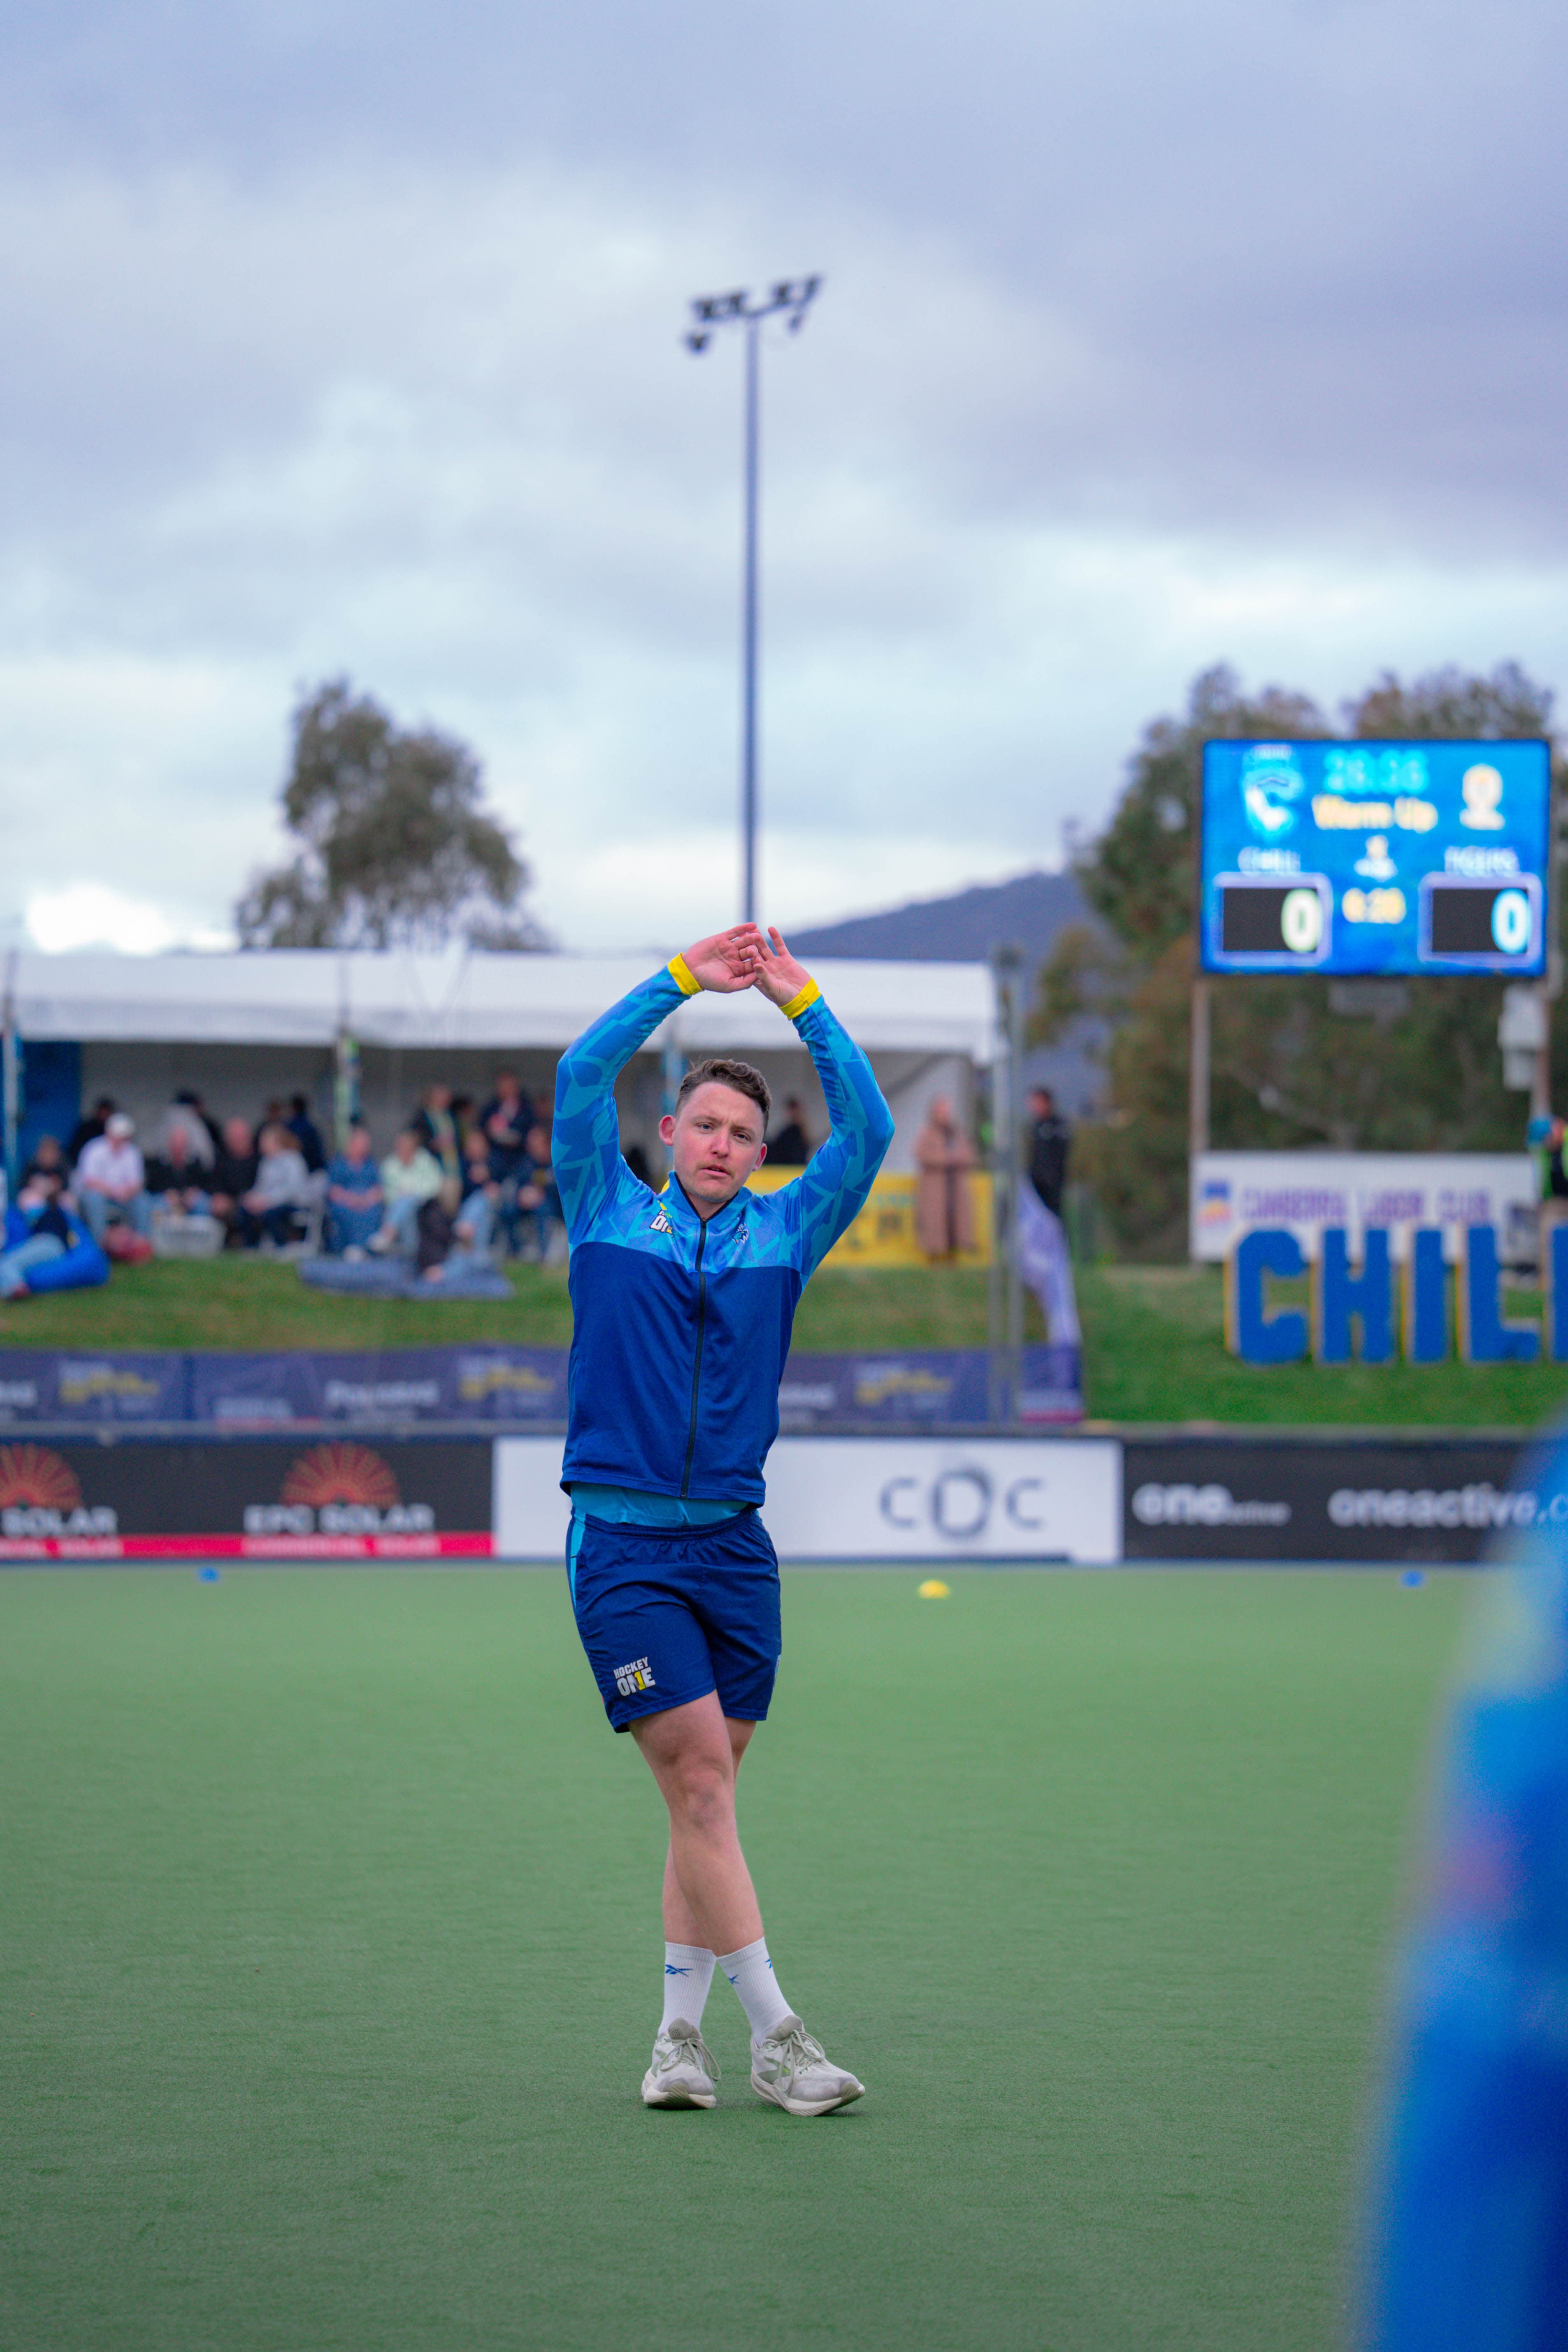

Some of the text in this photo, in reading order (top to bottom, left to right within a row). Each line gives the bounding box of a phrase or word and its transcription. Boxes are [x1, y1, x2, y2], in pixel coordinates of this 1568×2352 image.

[1312, 794, 1394, 830] Warm
[1394, 796, 1438, 833] Up
[1281, 888, 1322, 952] 0
[1491, 888, 1531, 953] 0
[2, 1505, 118, 1537] SOLAR
[244, 1503, 435, 1535] EPC SOLAR
[1132, 1483, 1232, 1526] one
[613, 1657, 648, 1679] HOCKEY
